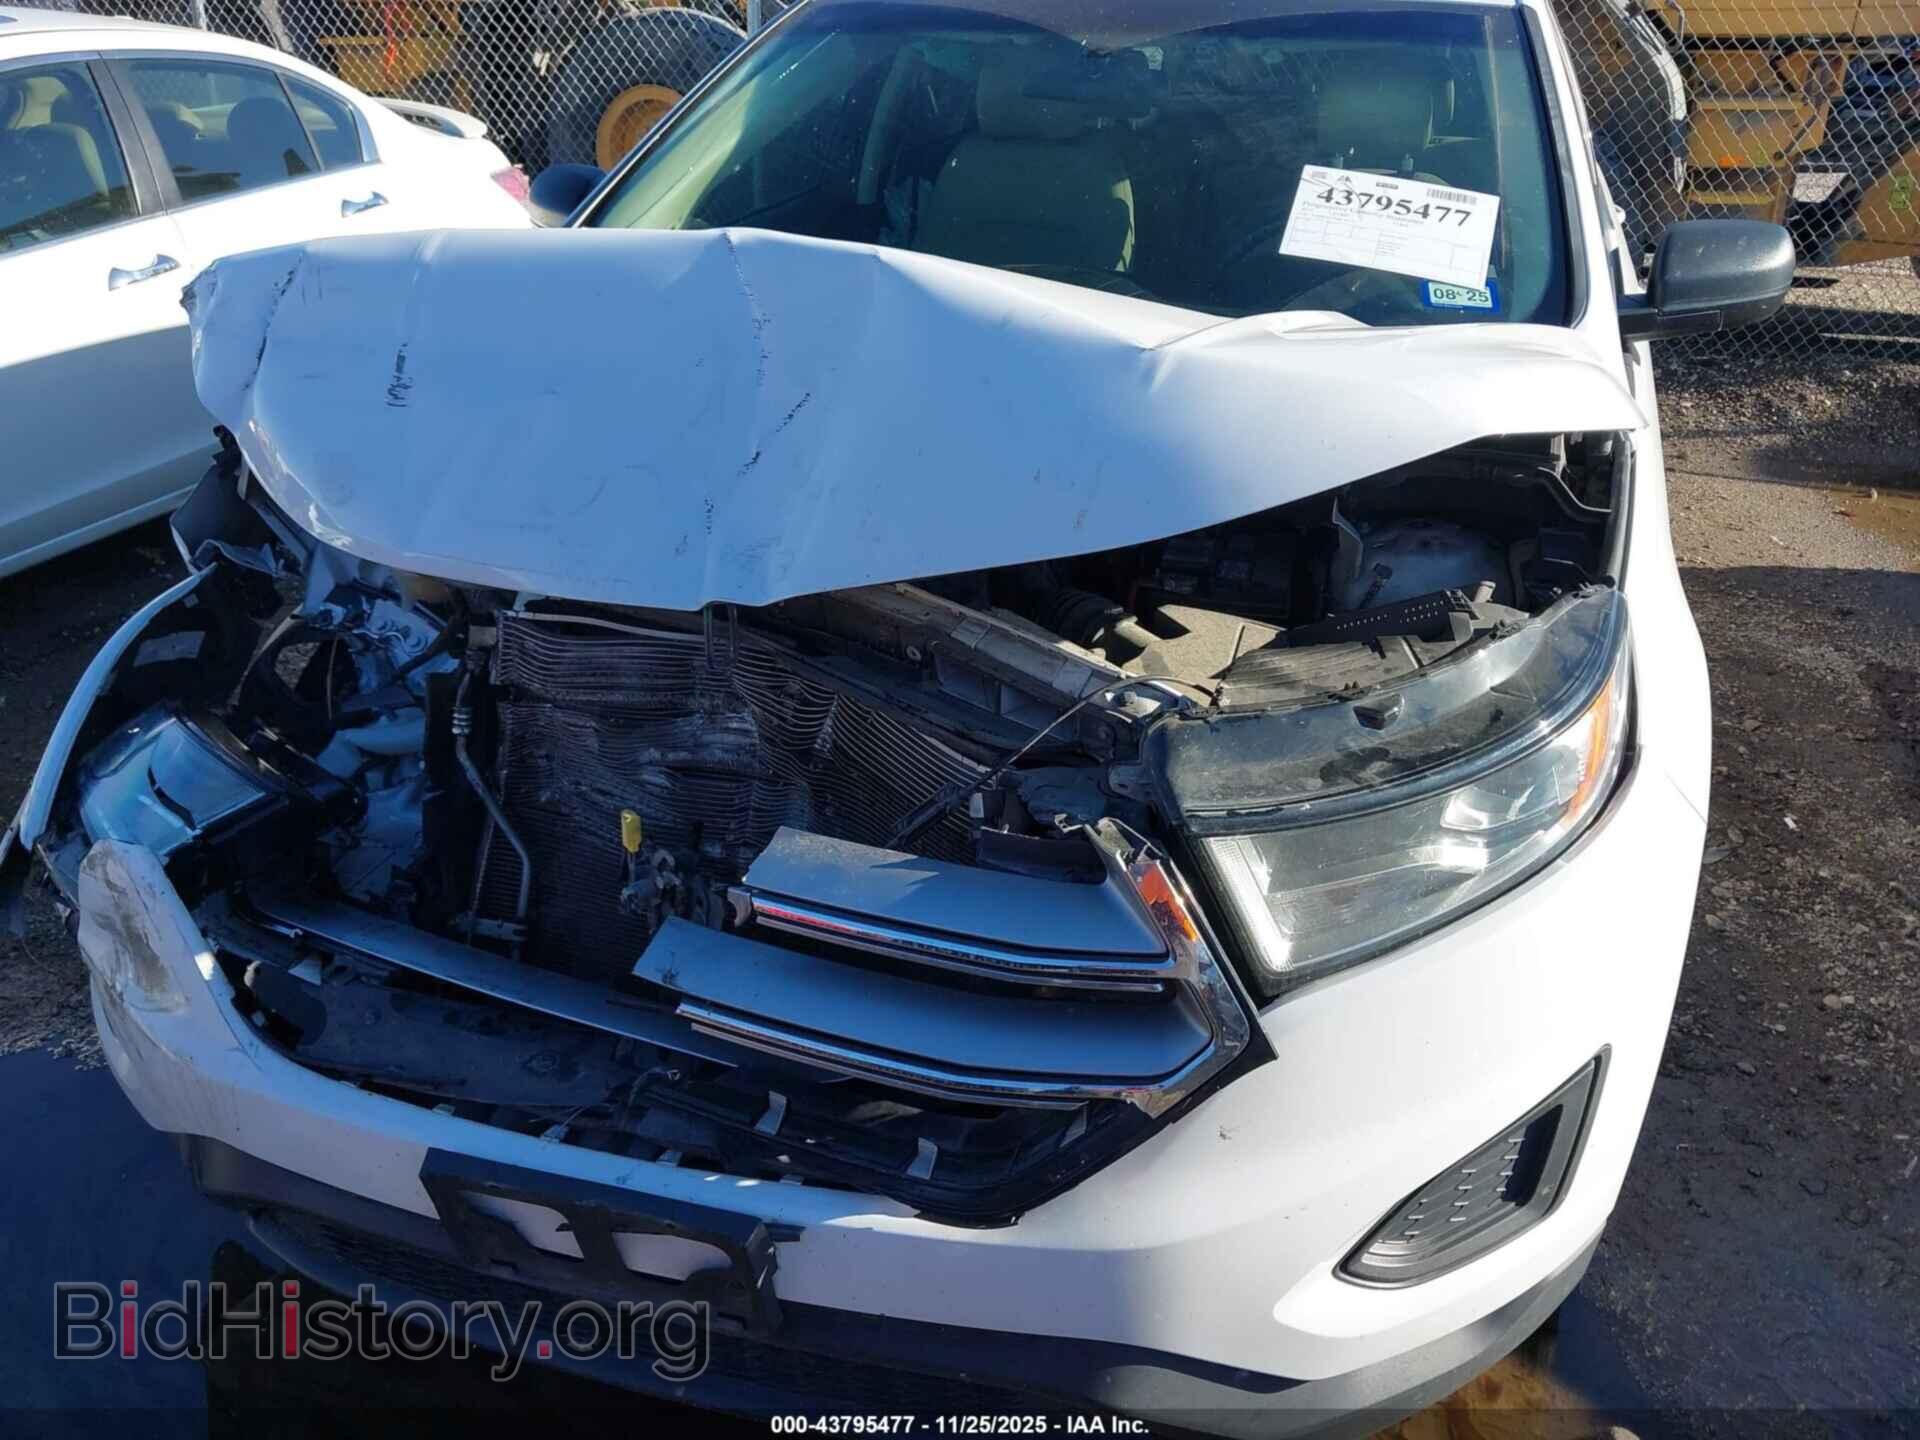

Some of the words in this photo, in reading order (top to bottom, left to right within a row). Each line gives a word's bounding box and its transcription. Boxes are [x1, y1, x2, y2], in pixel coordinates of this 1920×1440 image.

[1316, 187, 1472, 227] 43795477
[1433, 287, 1456, 300] 08
[1466, 289, 1489, 303] 25
